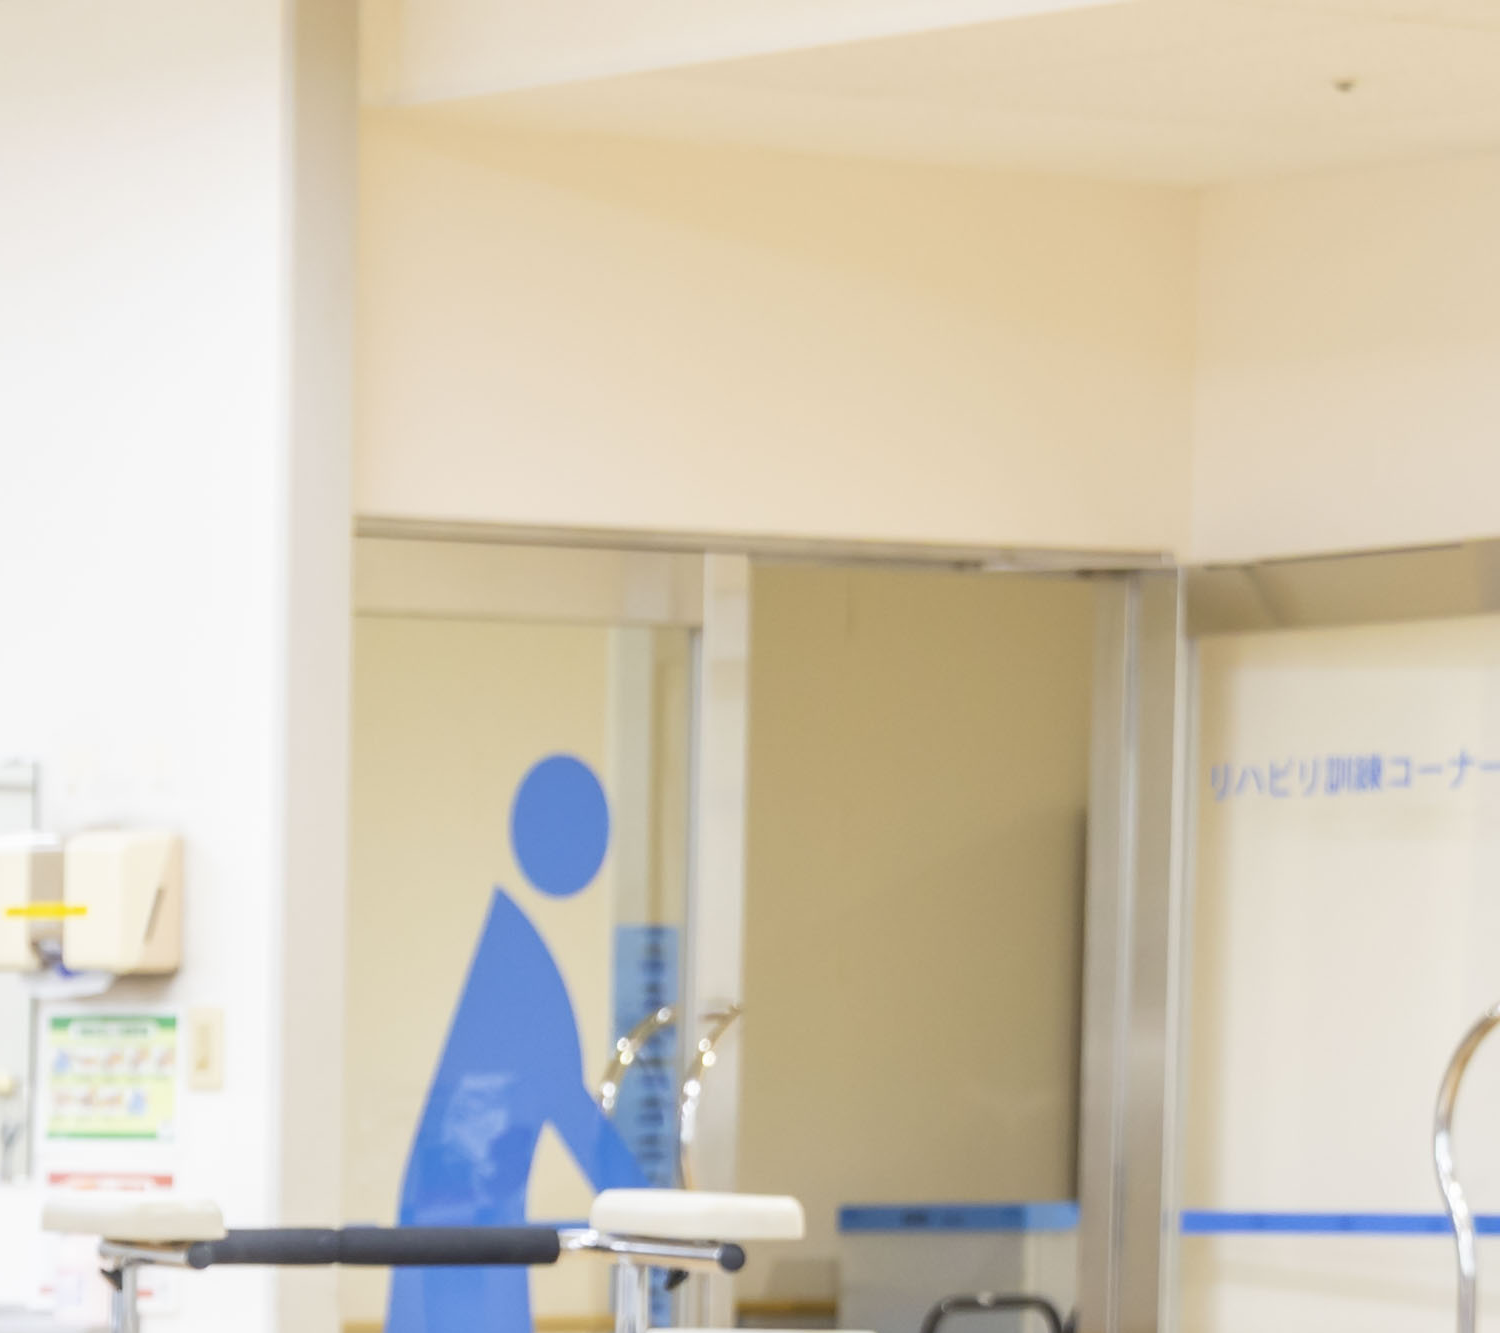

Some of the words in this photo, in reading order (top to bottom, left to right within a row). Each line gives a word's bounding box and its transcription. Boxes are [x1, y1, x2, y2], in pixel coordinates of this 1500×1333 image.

[1209, 746, 1500, 802] リハビリ訓練コーナー
